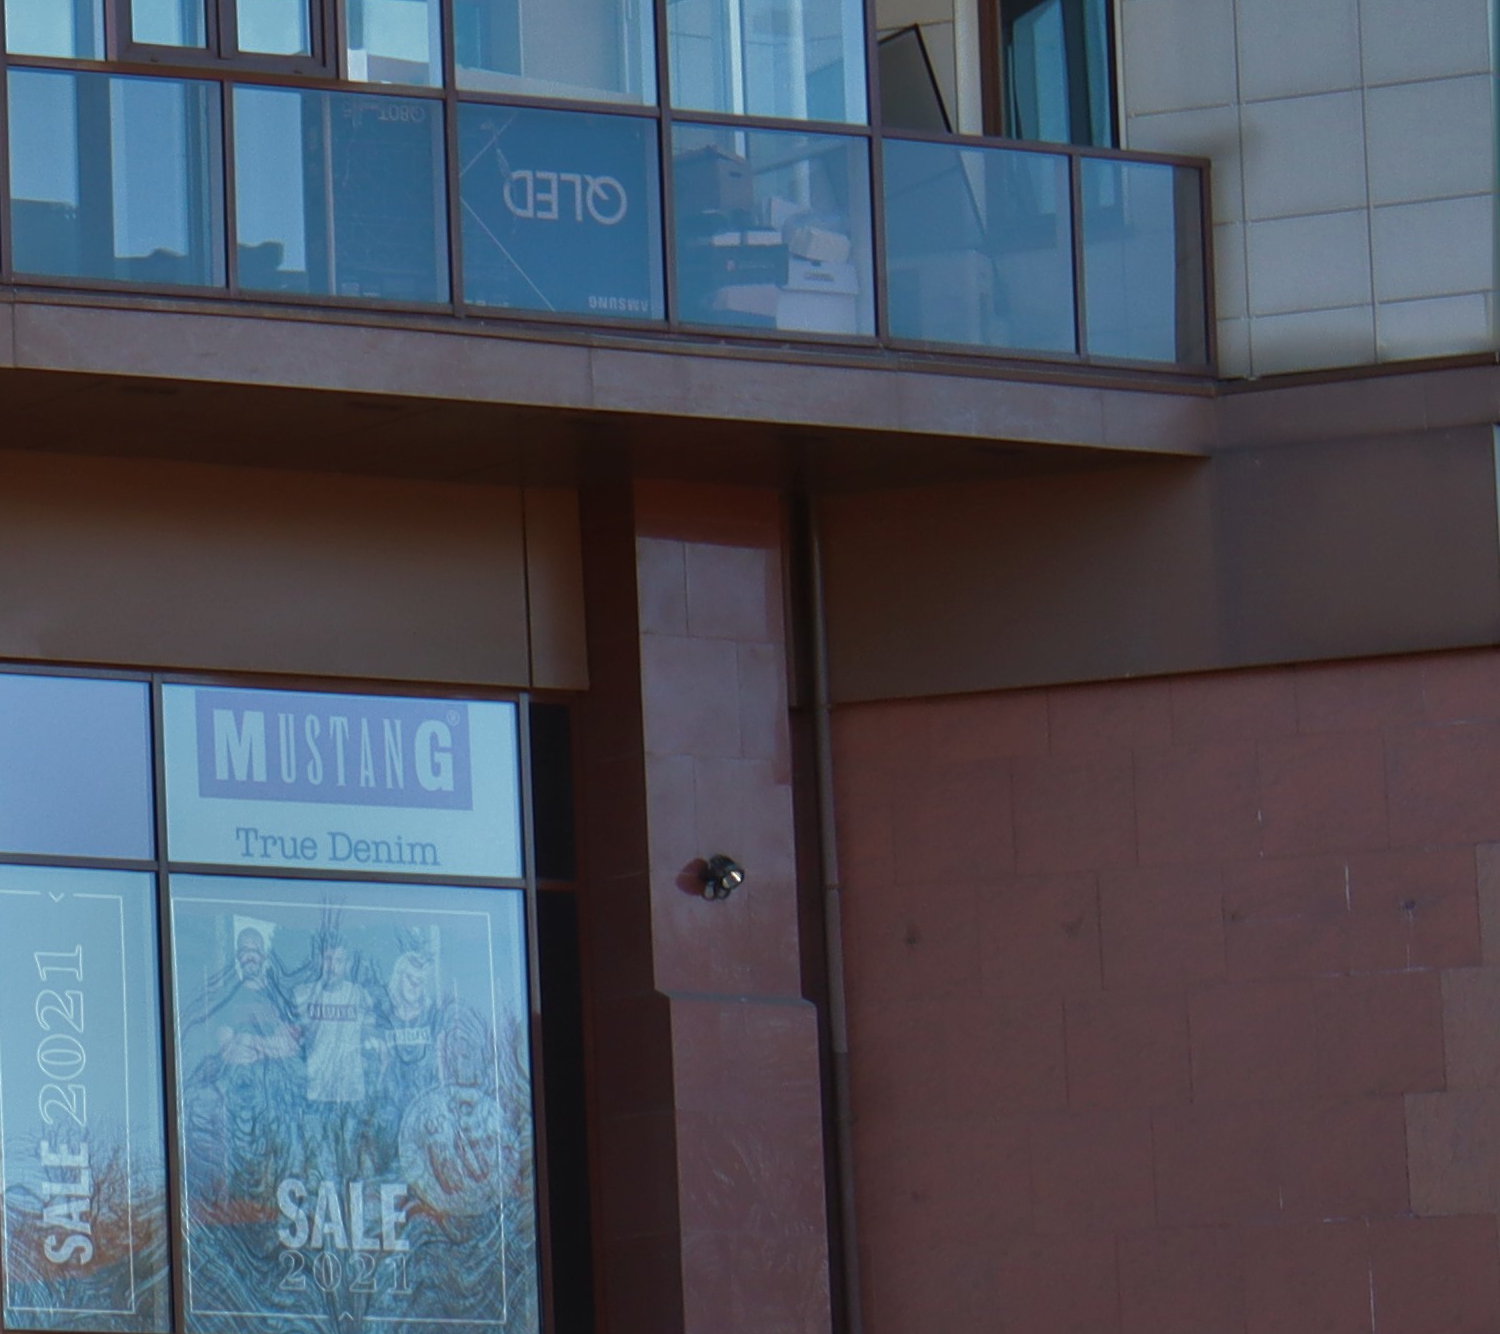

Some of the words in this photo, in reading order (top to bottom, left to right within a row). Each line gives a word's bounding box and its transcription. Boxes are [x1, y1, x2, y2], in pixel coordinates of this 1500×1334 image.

[503, 170, 628, 225] QLED
[588, 295, 650, 313] AMSUNG
[213, 708, 455, 792] MUSTANG
[235, 827, 318, 861] True
[327, 831, 441, 866] Denim
[33, 944, 87, 1127] 2021
[40, 1139, 94, 1266] SALE
[276, 1178, 410, 1252] SALE
[278, 1249, 413, 1294] 2021
